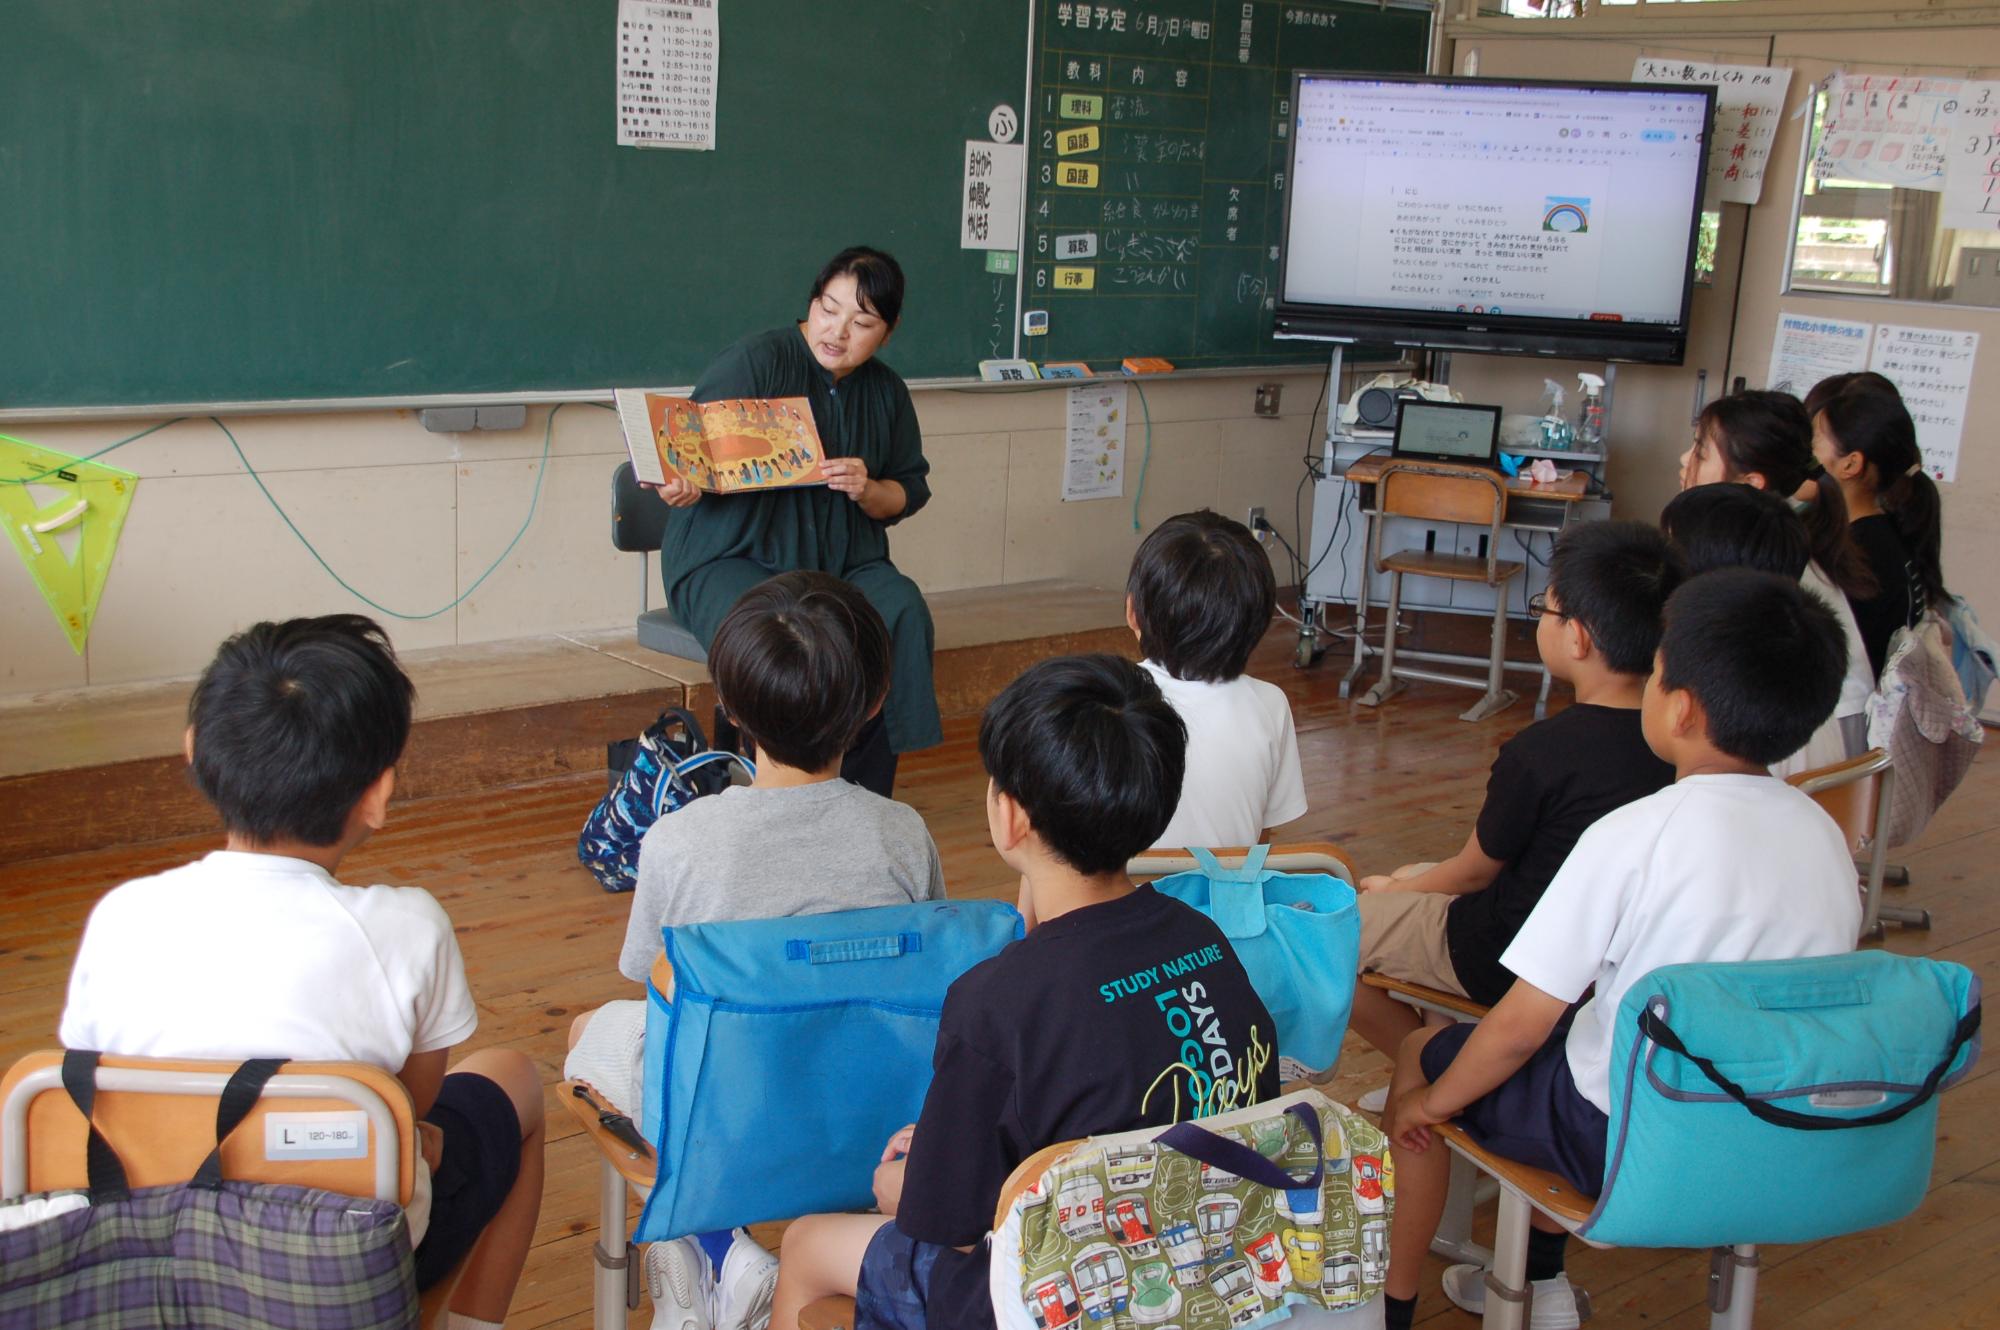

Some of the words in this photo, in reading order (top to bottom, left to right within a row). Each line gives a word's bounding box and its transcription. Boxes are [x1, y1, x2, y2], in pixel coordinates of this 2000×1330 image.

[1058, 3, 1127, 33] 学習予定
[1066, 61, 1102, 81] 教科
[1132, 66, 1188, 88] 内容
[1047, 95, 1052, 112] 1
[1071, 99, 1092, 115] 理科
[994, 111, 1014, 137] ふ
[1043, 130, 1053, 149] 2
[1067, 133, 1089, 150] 国語
[1041, 162, 1052, 183] 3
[1066, 168, 1089, 184] 国語
[1039, 200, 1049, 218] 4
[1226, 187, 1241, 242] 欠席者
[1038, 235, 1048, 253] 5
[1068, 239, 1089, 254] 算数
[1036, 269, 1046, 287] 6
[1064, 272, 1083, 286] 行事
[1099, 967, 1160, 1003] STUDY
[1161, 943, 1224, 980] NATURE
[284, 1129, 295, 1144] L
